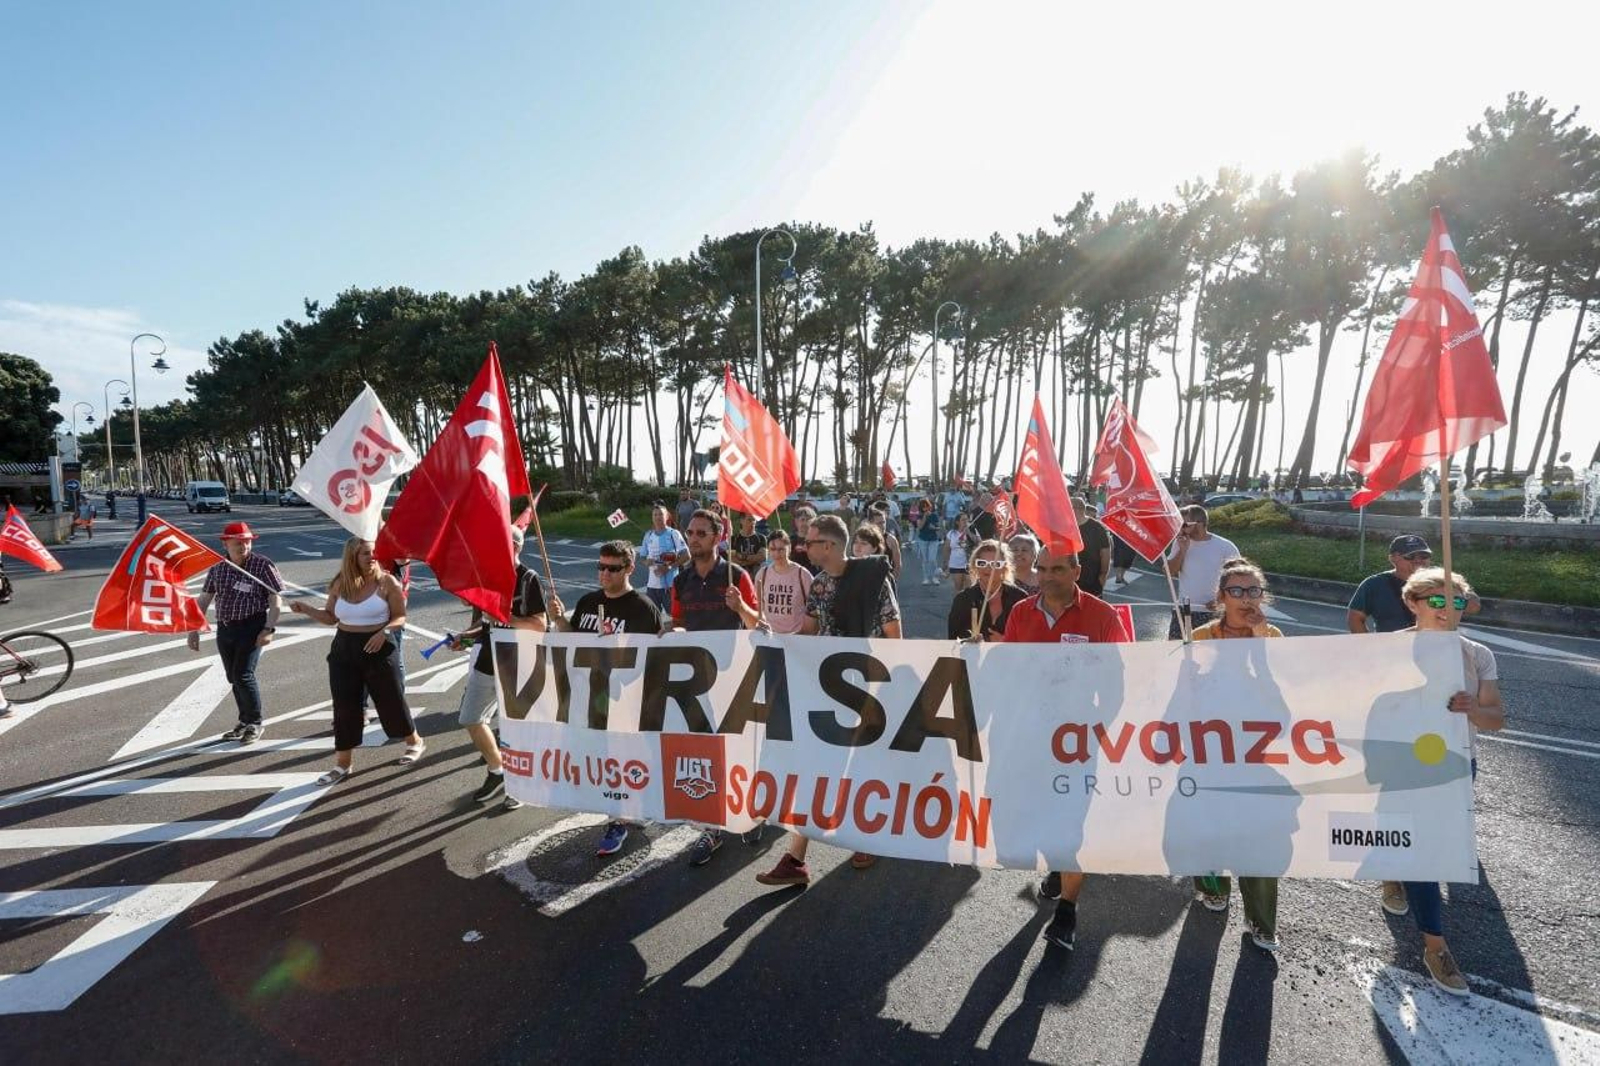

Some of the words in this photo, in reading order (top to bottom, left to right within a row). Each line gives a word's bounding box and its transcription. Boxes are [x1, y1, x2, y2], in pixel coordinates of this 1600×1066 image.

[768, 594, 792, 606] BITE
[769, 584, 793, 593] GIRLS
[768, 605, 792, 615] BACK
[495, 641, 983, 762] VITRASA
[1051, 719, 1345, 766] avanza
[585, 757, 650, 791] USO
[675, 756, 712, 784] UGT
[602, 791, 630, 801] vigo
[1052, 774, 1198, 798] GRUPO
[726, 764, 993, 849] SOLUCIÓN
[1331, 828, 1412, 849] HORARIOS
